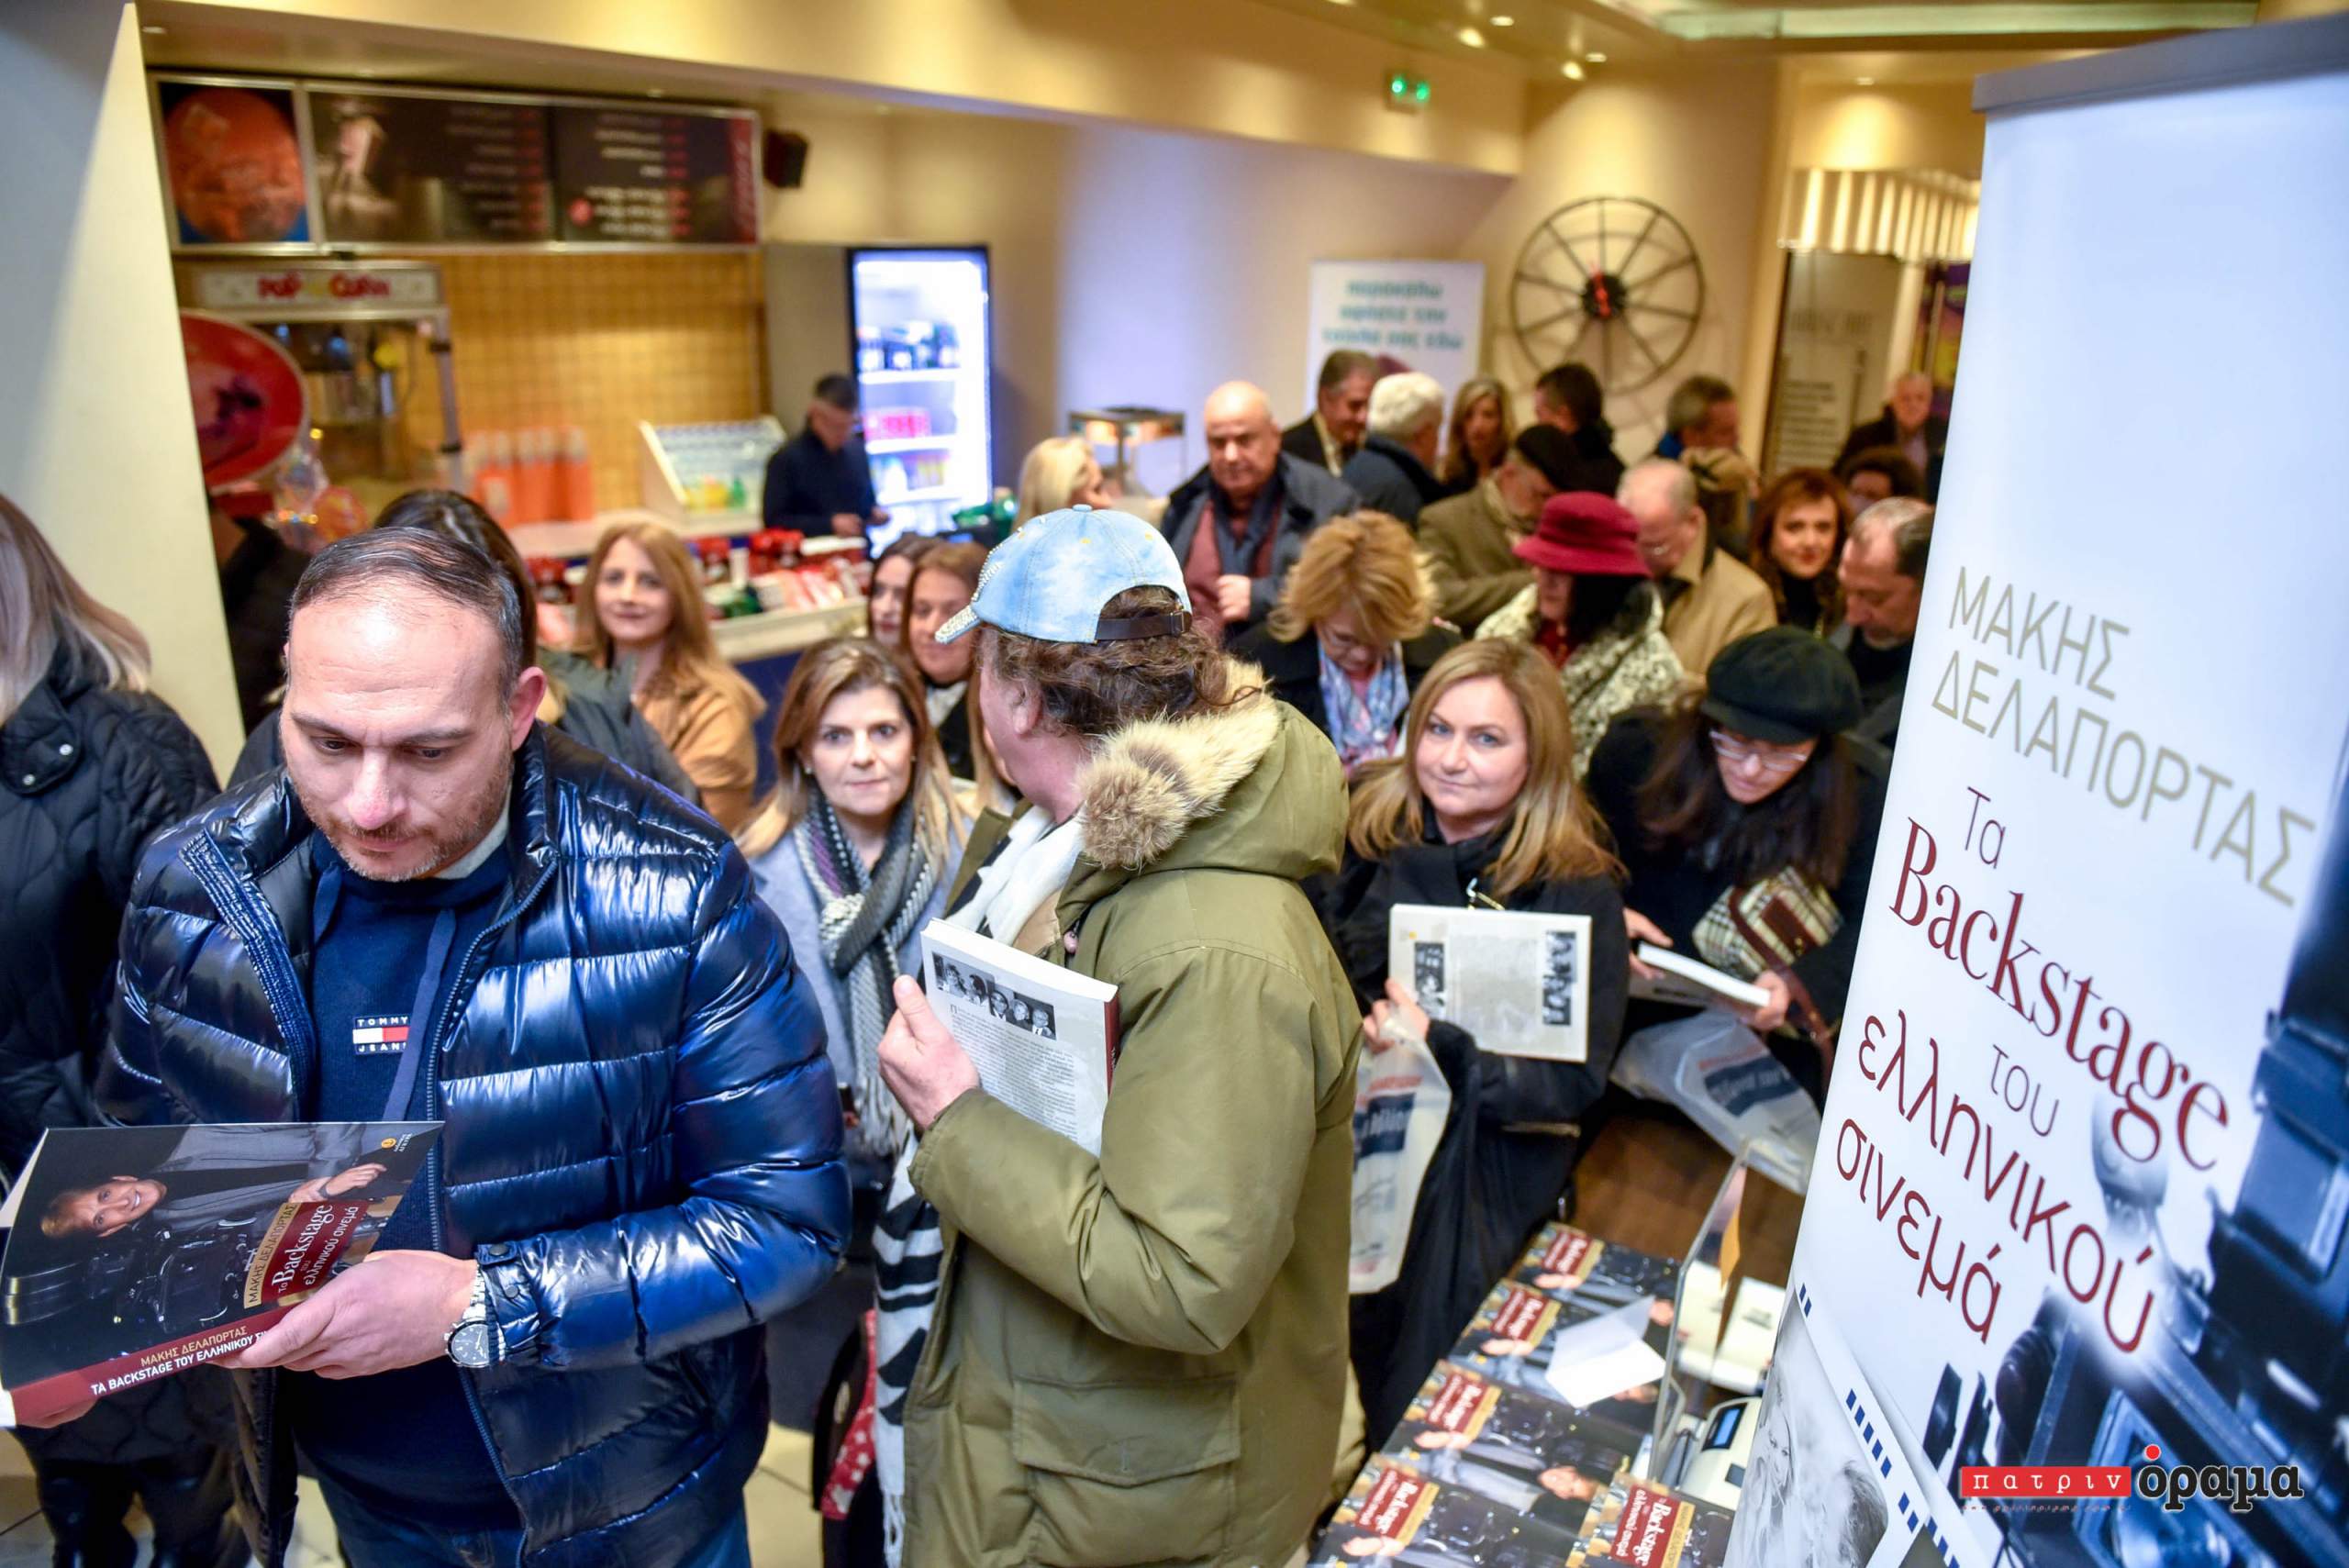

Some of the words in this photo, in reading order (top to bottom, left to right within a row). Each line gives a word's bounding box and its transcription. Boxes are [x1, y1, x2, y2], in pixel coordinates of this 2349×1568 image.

[1949, 566, 2131, 701] ΜΑΚΗΣ
[1931, 650, 2316, 908] ΔΕΛΑΠΟΡΤΑΣ
[1964, 786, 2006, 870] Τα
[357, 1017, 408, 1027] TOMMY
[1888, 817, 2230, 1172] Backstage
[1991, 1044, 2060, 1138] του
[1857, 1009, 2155, 1353] ελληνικού
[271, 1204, 335, 1286] Backstage
[305, 1237, 340, 1285] ελληνικού
[333, 1206, 360, 1237] σινεμά
[1836, 1118, 2002, 1344] σινεμά
[249, 1256, 265, 1303] ΜΑΚΗΣ
[91, 1382, 106, 1396] ΤΑ
[108, 1363, 174, 1390] BACKSTAGE
[175, 1355, 194, 1368] ΤΟΥ
[196, 1337, 254, 1362] ΕΛΛΗΝΙΚΟΥ
[140, 1347, 180, 1367] ΜΑΚΗΣ
[181, 1325, 248, 1353] ΔΕΛΑΠΟΡΤΑΣ
